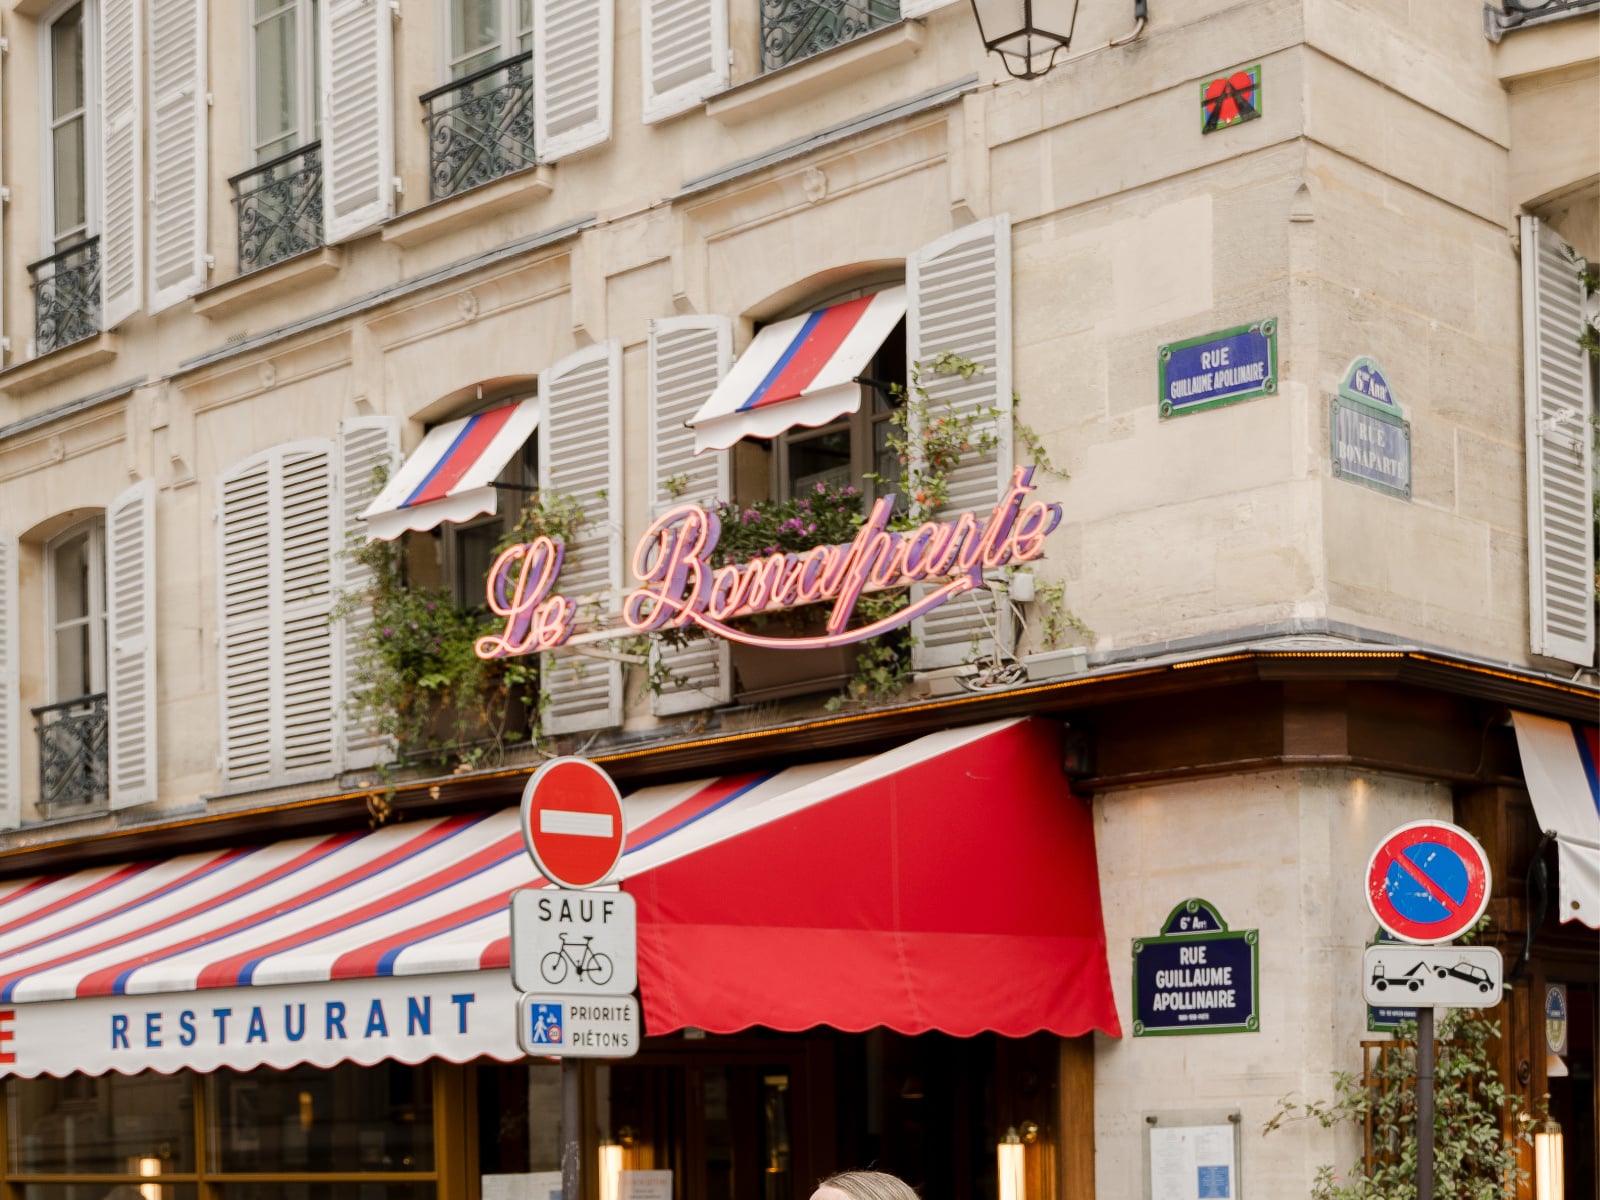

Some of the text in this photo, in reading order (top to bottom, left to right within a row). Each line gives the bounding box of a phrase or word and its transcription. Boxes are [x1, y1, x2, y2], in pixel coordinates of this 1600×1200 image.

[1201, 347, 1230, 370] RUE
[1170, 361, 1264, 399] GUILLAUME APOLLINAIRE
[1359, 423, 1385, 448] RUE
[1339, 441, 1405, 479] BONAPARTE
[474, 465, 1063, 659] Le Bonaparte
[538, 898, 614, 924] SAUF
[1180, 946, 1207, 965] RUE
[1155, 966, 1233, 988] GUILLAUME
[1153, 989, 1236, 1011] APOLLINAIRE
[111, 994, 476, 1050] RESTAURANT
[570, 1004, 631, 1021] PRIORITÉ
[572, 1029, 629, 1047] PIÉTONS
